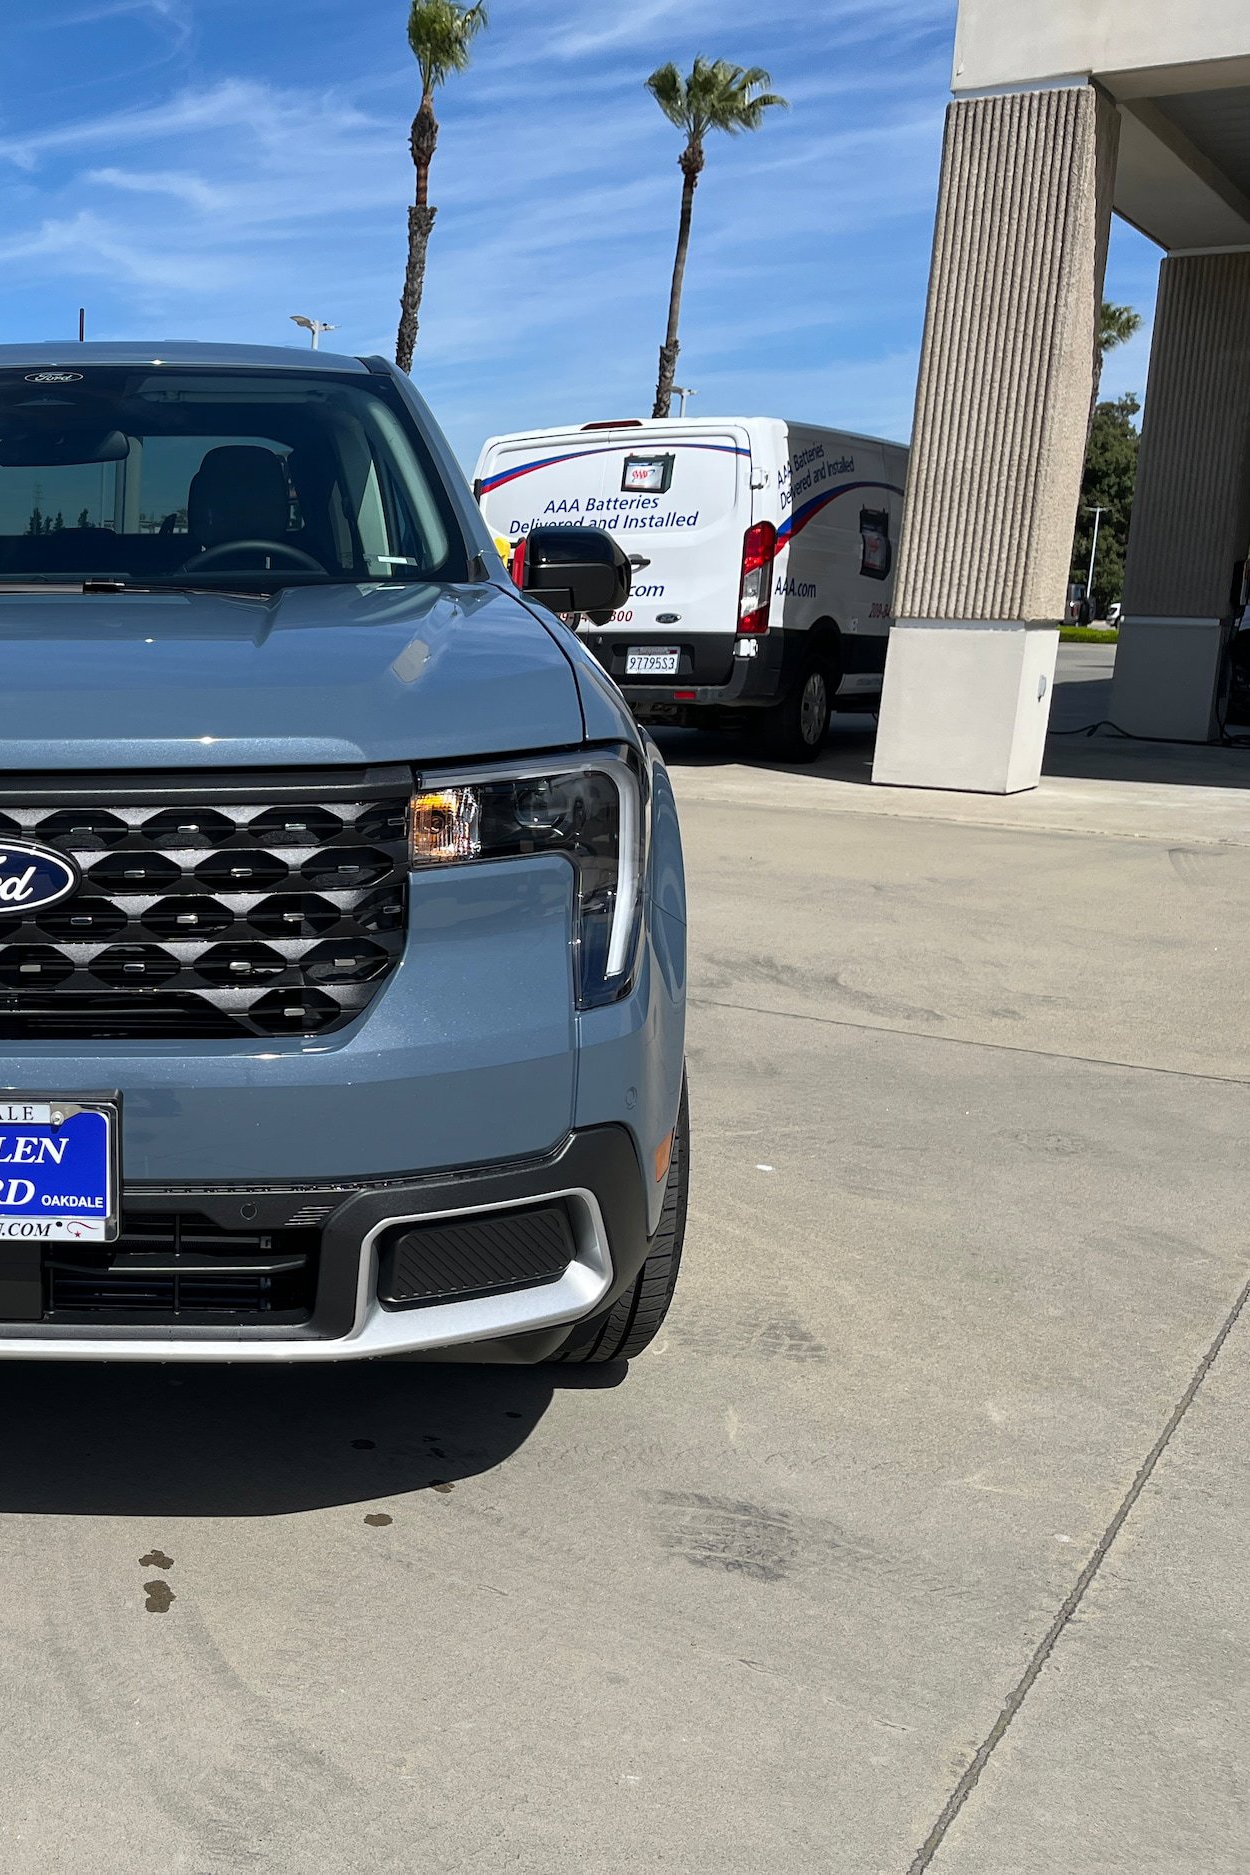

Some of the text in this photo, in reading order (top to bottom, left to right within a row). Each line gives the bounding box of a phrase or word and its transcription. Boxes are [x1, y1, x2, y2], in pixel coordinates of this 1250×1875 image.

[35, 373, 73, 381] Ford
[793, 442, 825, 472] Batteries
[813, 461, 827, 483] and
[827, 455, 855, 477] Installed
[543, 494, 660, 514] AAA Batteries
[588, 514, 620, 530] and
[623, 511, 699, 529] Installed
[628, 585, 665, 597] com
[774, 576, 817, 598] AAA.com
[629, 657, 675, 670] 97795S3
[41, 1194, 104, 1209] OAKDALE
